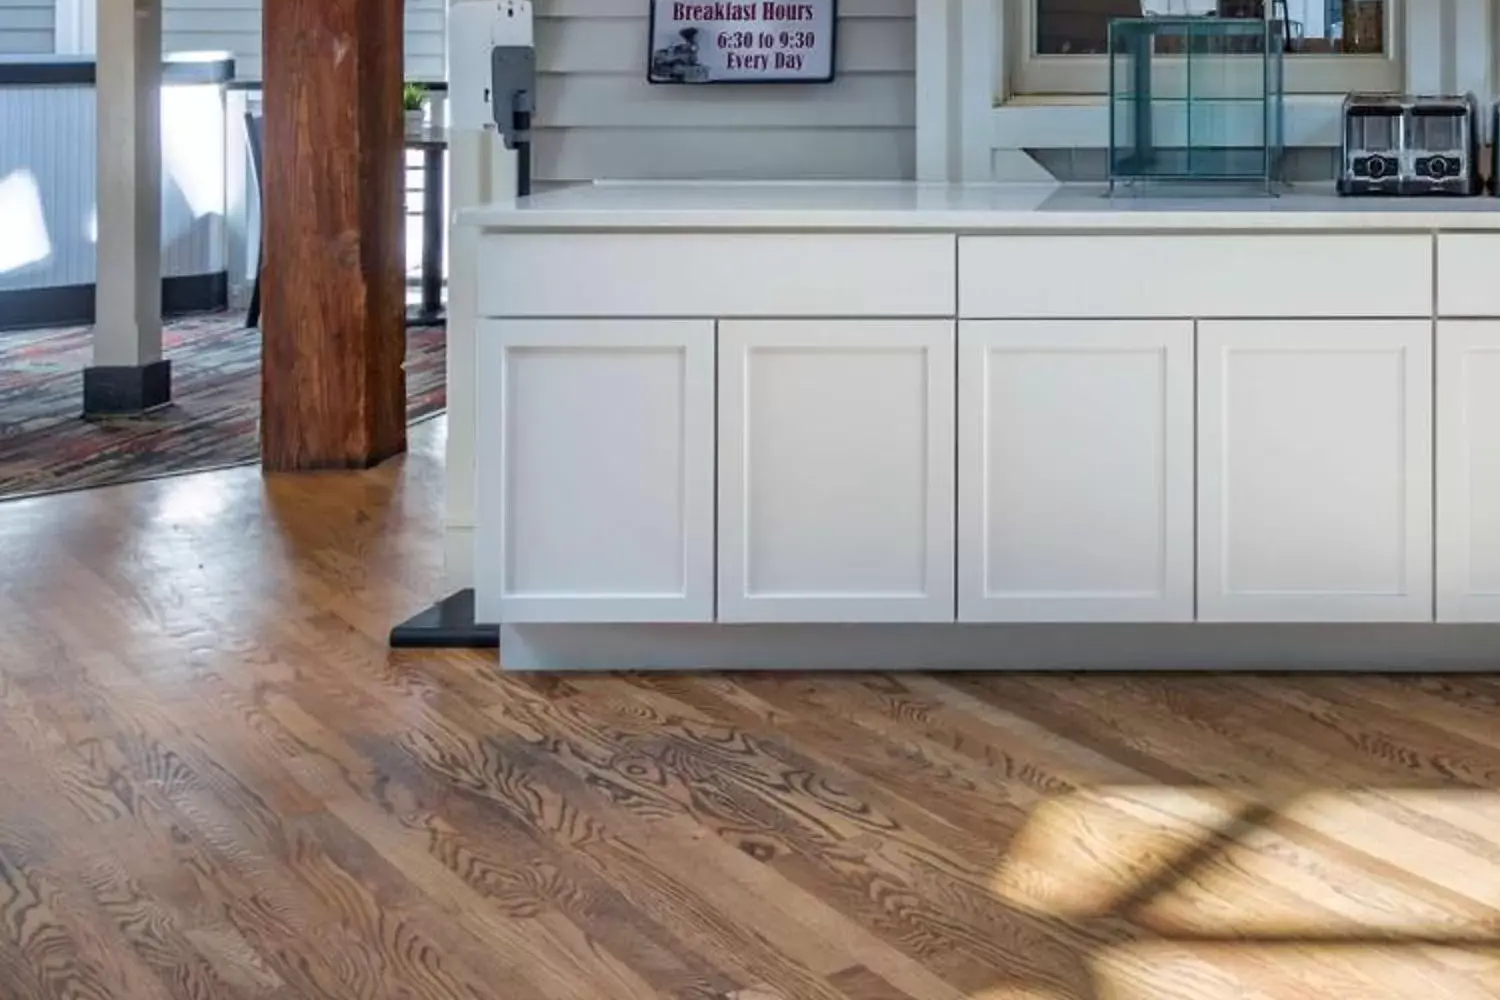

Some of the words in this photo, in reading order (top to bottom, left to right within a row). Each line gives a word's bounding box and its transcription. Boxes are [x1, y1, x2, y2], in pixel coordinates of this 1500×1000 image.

[672, 2, 756, 20] Breakfast
[762, 2, 813, 20] Hours
[717, 32, 752, 49] 6:30
[759, 32, 773, 49] to
[779, 32, 815, 49] 9:30
[727, 52, 768, 70] Every
[774, 52, 803, 70] Day
